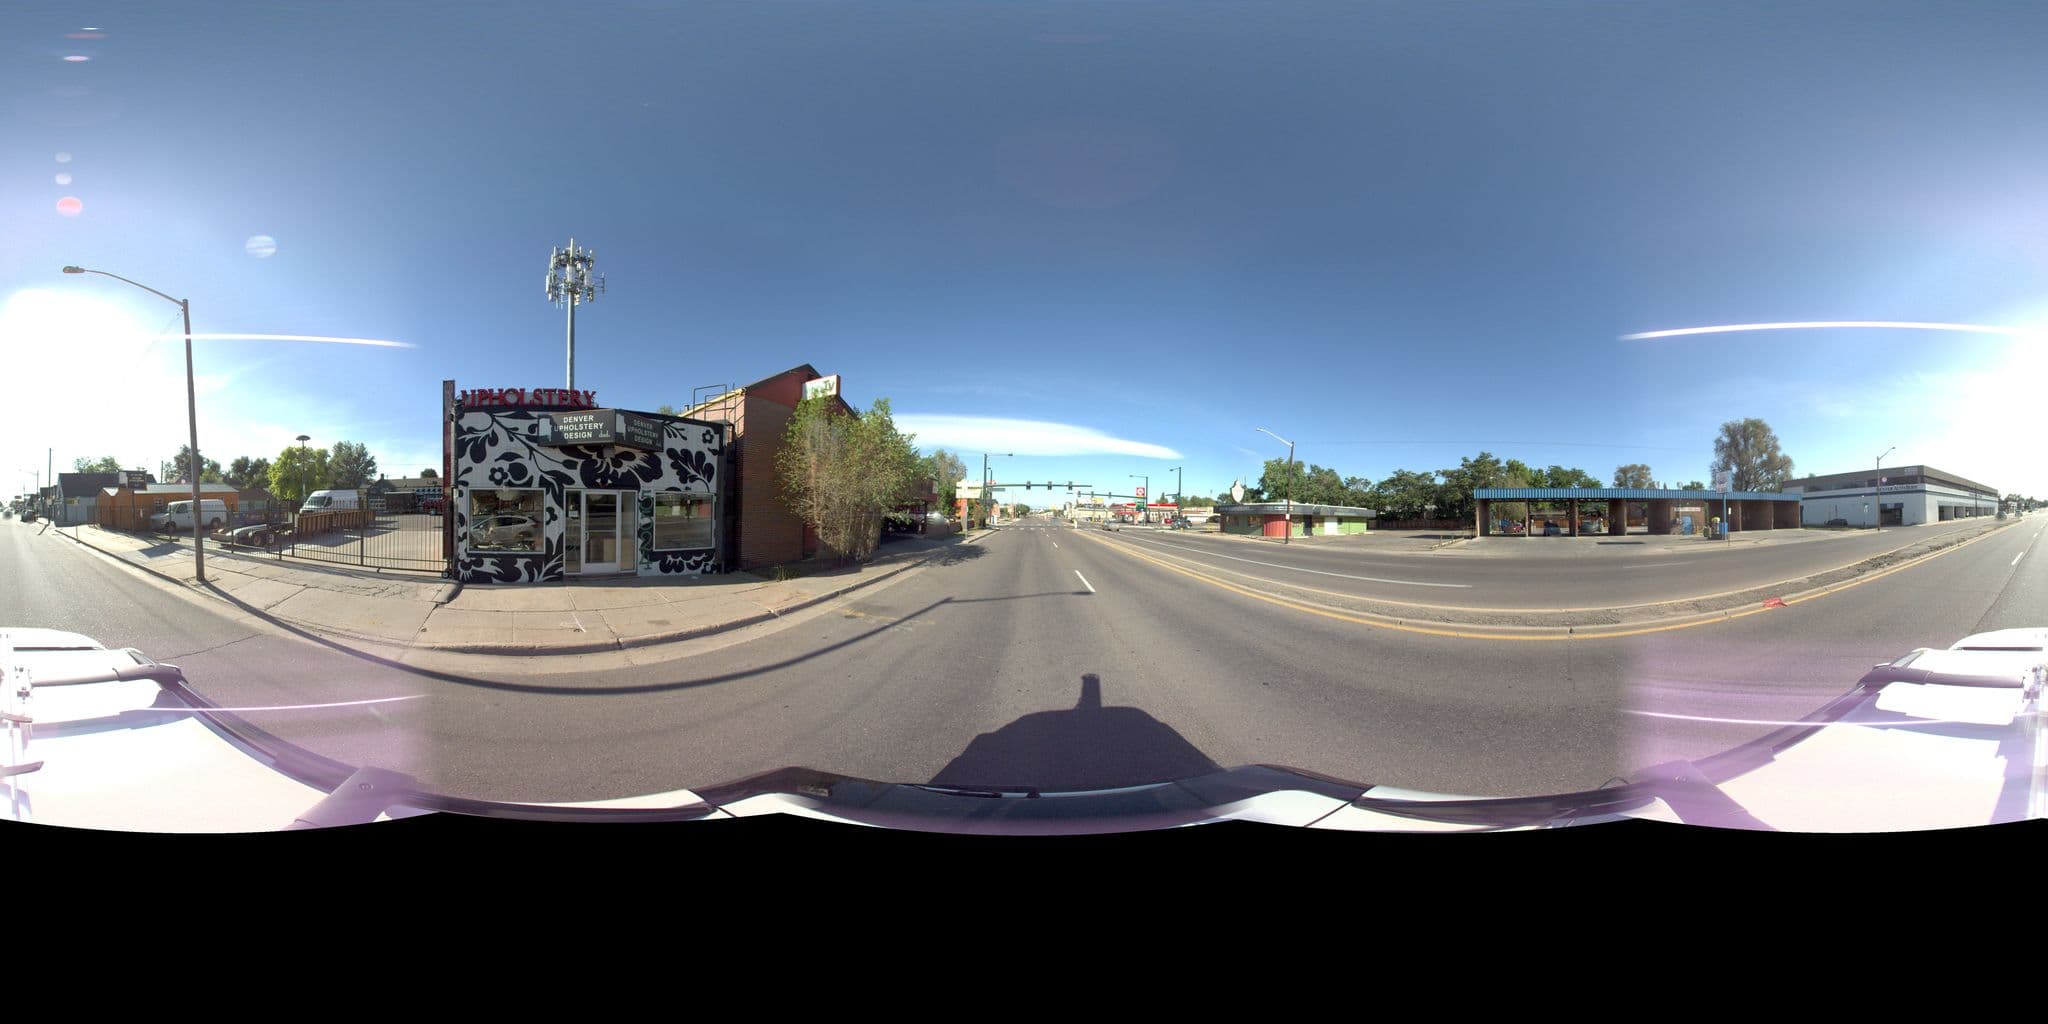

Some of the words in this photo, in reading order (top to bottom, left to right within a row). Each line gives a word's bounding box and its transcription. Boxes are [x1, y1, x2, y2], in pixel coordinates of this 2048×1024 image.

[461, 388, 596, 408] UPHOLSTERY
[563, 415, 594, 423] DENVER
[633, 418, 653, 429] DENVER
[554, 422, 604, 432] UPHOLSTERY
[564, 431, 593, 440] DESIGN
